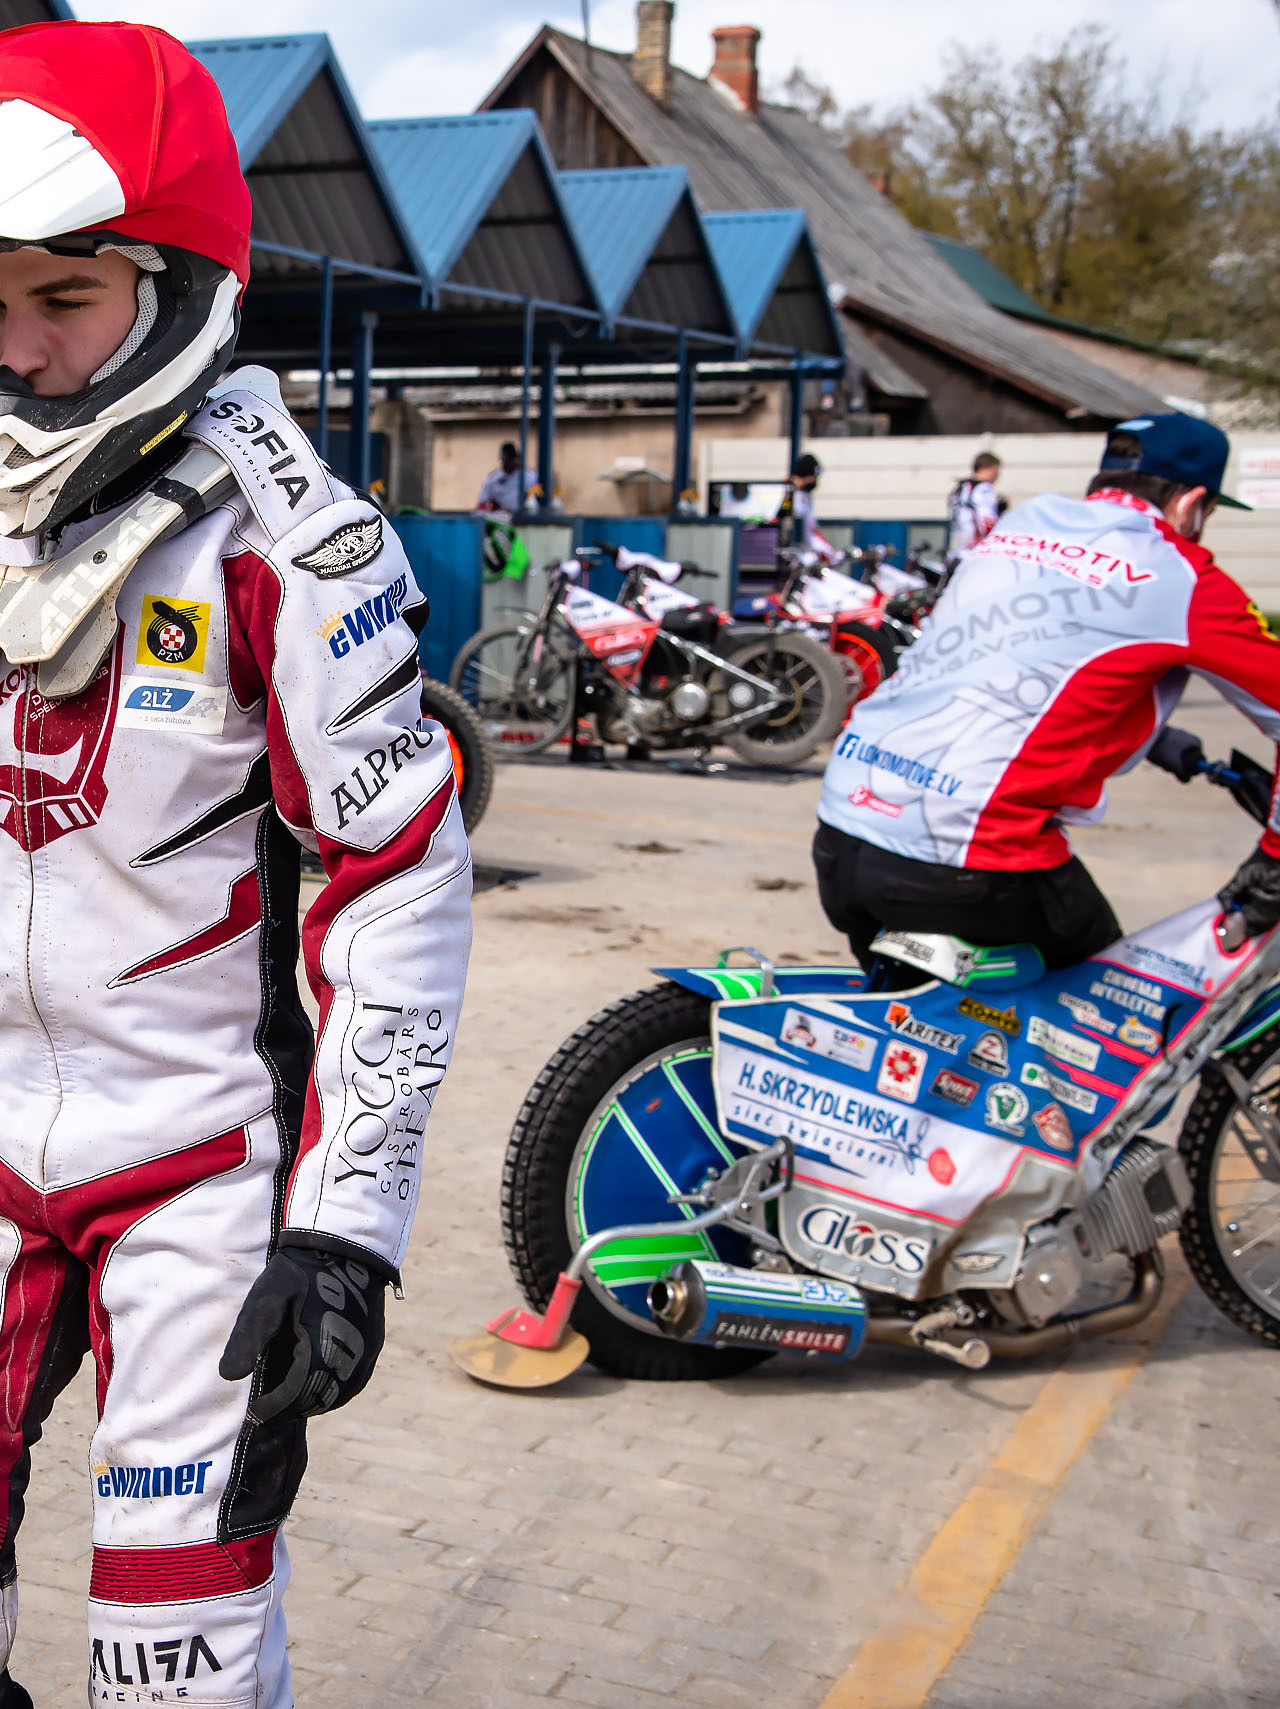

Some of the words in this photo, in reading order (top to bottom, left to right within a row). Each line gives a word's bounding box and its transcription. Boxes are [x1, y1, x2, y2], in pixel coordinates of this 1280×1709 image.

[210, 401, 310, 510] SOFIA
[211, 425, 267, 490] DAUGAVPILS
[328, 572, 408, 659] eWinner
[157, 648, 184, 664] PZM
[140, 687, 173, 709] 2LŻ
[739, 1062, 756, 1090] H.
[759, 1070, 909, 1142] SKRZYDLEWSKA
[97, 1459, 214, 1499] eWinner
[92, 1634, 223, 1685] ALIFA
